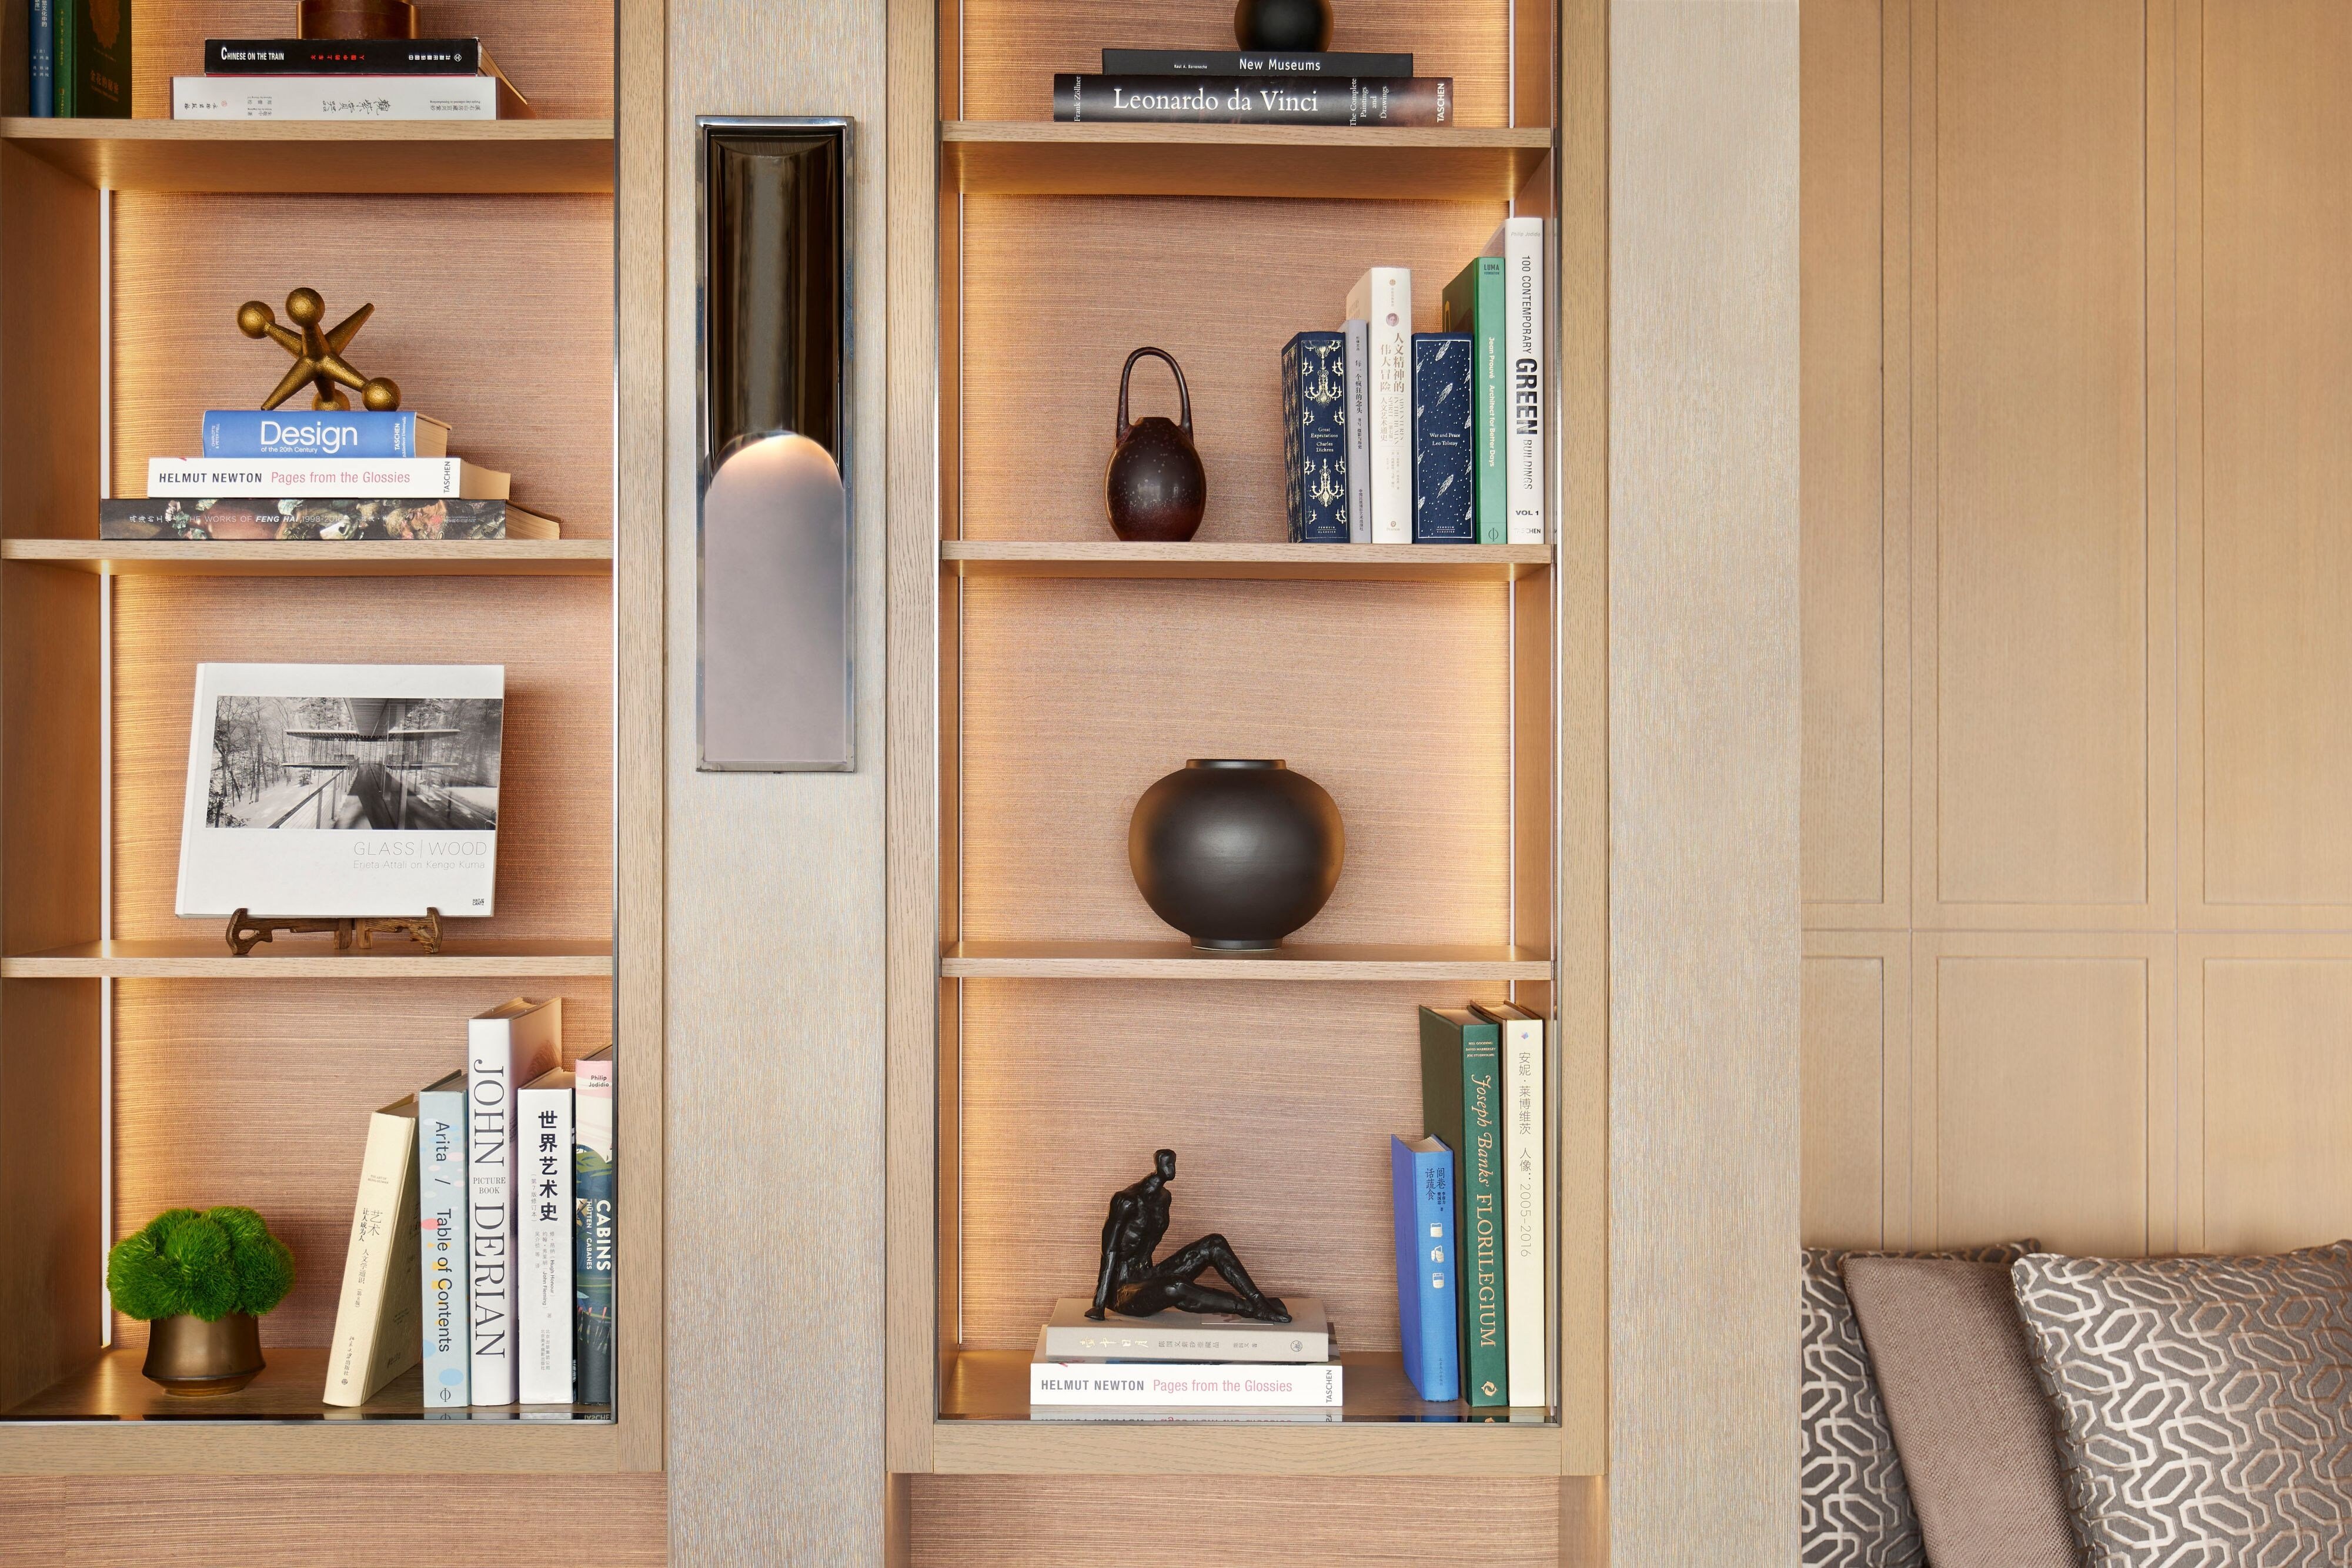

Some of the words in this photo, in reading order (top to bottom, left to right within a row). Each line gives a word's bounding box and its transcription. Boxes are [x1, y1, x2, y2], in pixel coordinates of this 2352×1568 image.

[221, 47, 246, 61] CHINESE
[1240, 59, 1265, 71] New
[1268, 59, 1321, 71] Museums
[1114, 86, 1218, 111] Leonardo
[1227, 88, 1252, 112] da
[1261, 89, 1318, 112] Vinci
[1350, 78, 1358, 111] Complete
[1360, 86, 1369, 118] Paintings
[1380, 86, 1389, 119] Drawings
[1522, 255, 1532, 272] 100
[1521, 276, 1532, 354] CONTEMPORARY
[1379, 344, 1391, 393] 伟大冒险
[1393, 332, 1405, 393] 人文精神的
[1355, 359, 1363, 414] 每一个疯狂的念头
[1515, 358, 1538, 435] GREEN
[260, 421, 358, 454] Design
[159, 473, 207, 483] HELMUT
[212, 473, 262, 483] NEWTON
[271, 472, 306, 486] Pages
[310, 472, 338, 483] from
[340, 472, 359, 483] the
[363, 472, 410, 483] Glossies
[1522, 439, 1532, 490] BUILDINGS
[354, 841, 415, 855] GLASS
[429, 841, 487, 855] WOOD
[353, 860, 379, 868] Erieta
[383, 860, 407, 868] Attali
[426, 860, 455, 870] Kengo
[459, 860, 485, 868] Kuma
[1471, 1074, 1492, 1128] Joseph
[1519, 1051, 1531, 1135] 安妮·莱博维茨
[474, 1058, 505, 1167] JOHN
[436, 1122, 450, 1162] Arita
[473, 1177, 506, 1186] PICTURE
[538, 1109, 559, 1222] 世界艺术史
[1436, 1168, 1446, 1189] 闾巷
[479, 1186, 500, 1195] BOOK
[1425, 1168, 1436, 1201] 话蔬食
[358, 1208, 370, 1242] 让人成为人
[368, 1209, 383, 1236] 艺术
[436, 1208, 452, 1252] Table
[596, 1199, 612, 1271] CABINS
[358, 1249, 369, 1285] 人文学通识
[436, 1256, 452, 1273] of
[474, 1202, 506, 1359] DERIAN
[1476, 1194, 1496, 1347] FLORILEGIUM
[437, 1279, 453, 1353] Contents
[1041, 1380, 1090, 1391] HELMUT
[1094, 1380, 1144, 1391] NEWTON
[1154, 1379, 1188, 1393] Pages
[1191, 1379, 1219, 1391] from
[1222, 1380, 1241, 1392] the
[1245, 1379, 1292, 1392] Glossies
